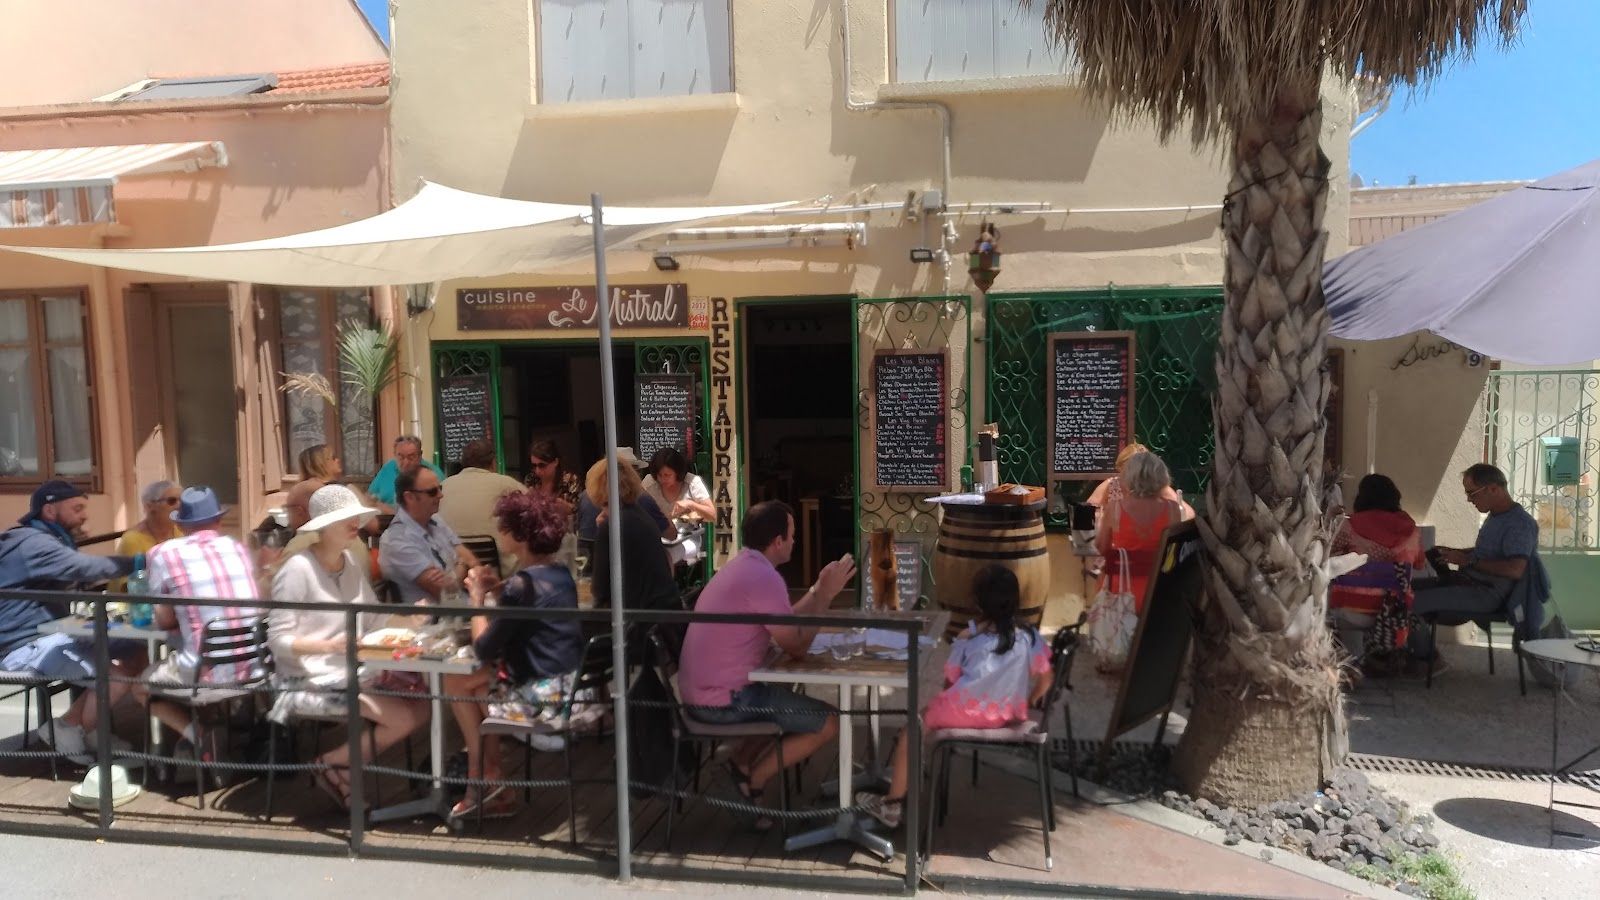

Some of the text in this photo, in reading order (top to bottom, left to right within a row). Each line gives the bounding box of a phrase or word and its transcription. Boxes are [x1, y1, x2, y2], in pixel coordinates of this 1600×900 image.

[464, 290, 536, 304] cuisine
[562, 284, 677, 326] Le Mistral
[711, 297, 733, 556] RESTAURANT
